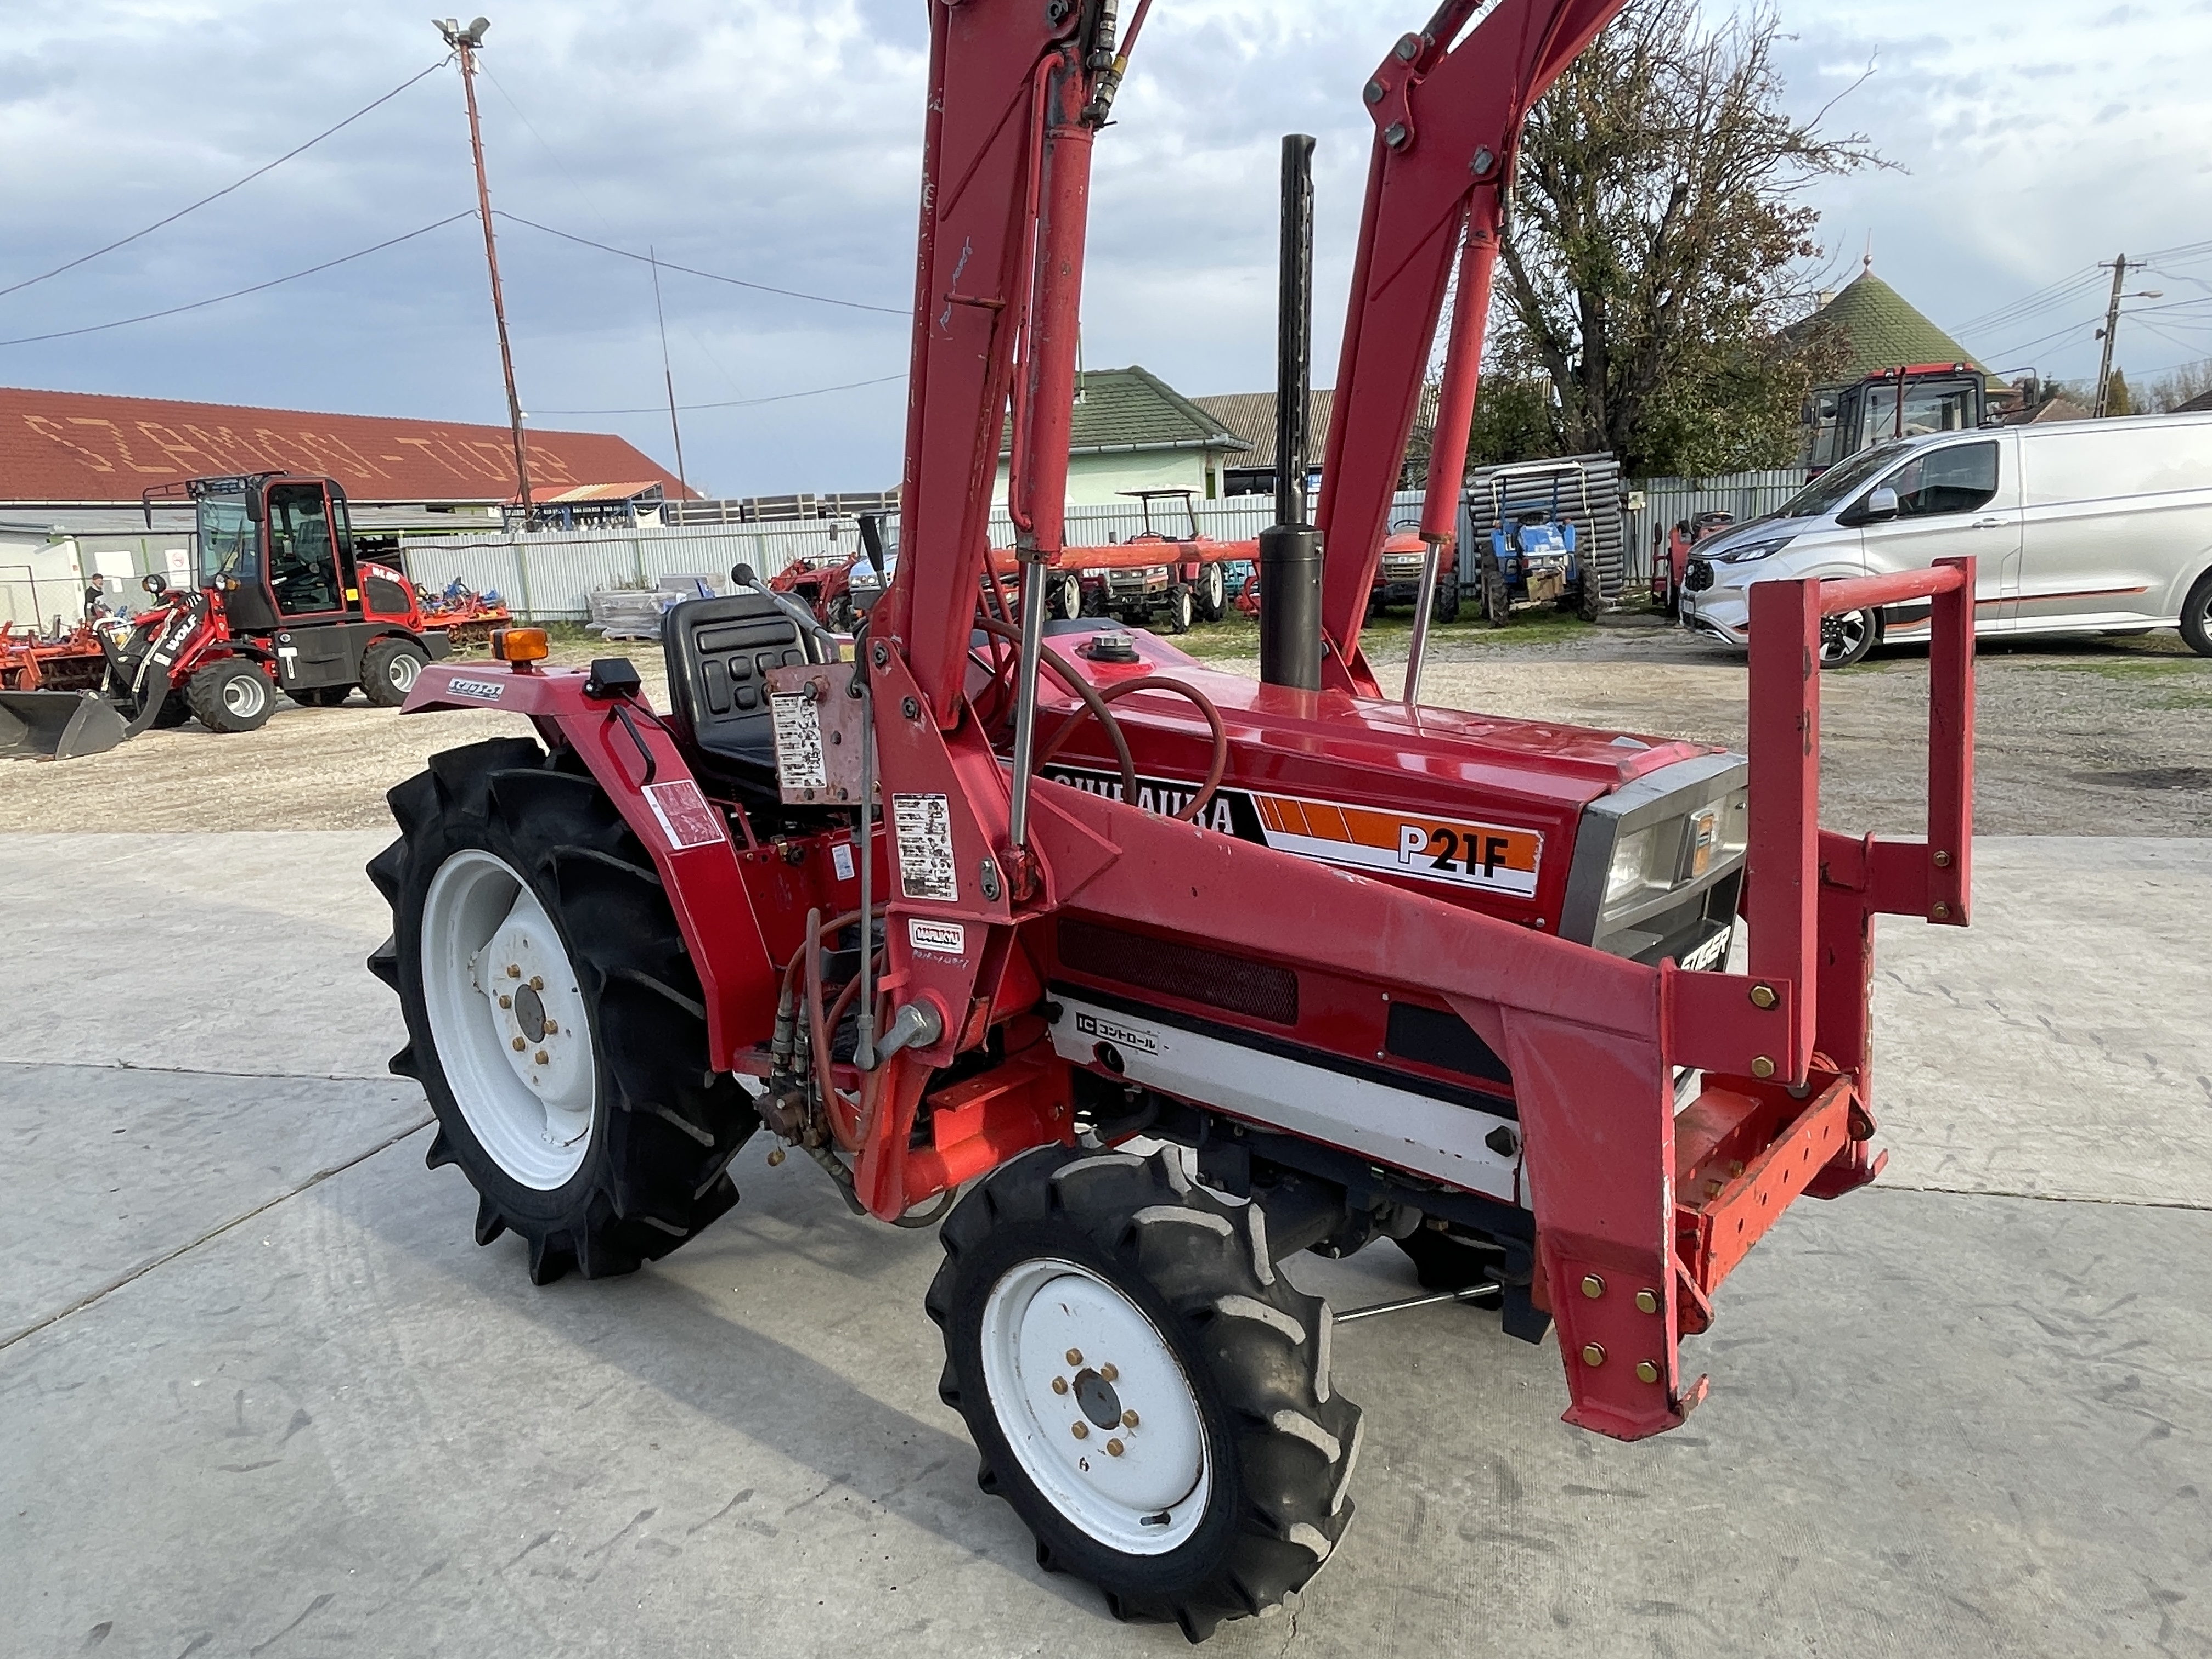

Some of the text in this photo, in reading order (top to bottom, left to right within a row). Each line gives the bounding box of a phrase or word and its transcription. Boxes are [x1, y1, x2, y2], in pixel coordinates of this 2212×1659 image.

[166, 614, 197, 651] WOLF
[1398, 823, 1509, 878] P21F
[1078, 1017, 1155, 1049] IC コントロール
